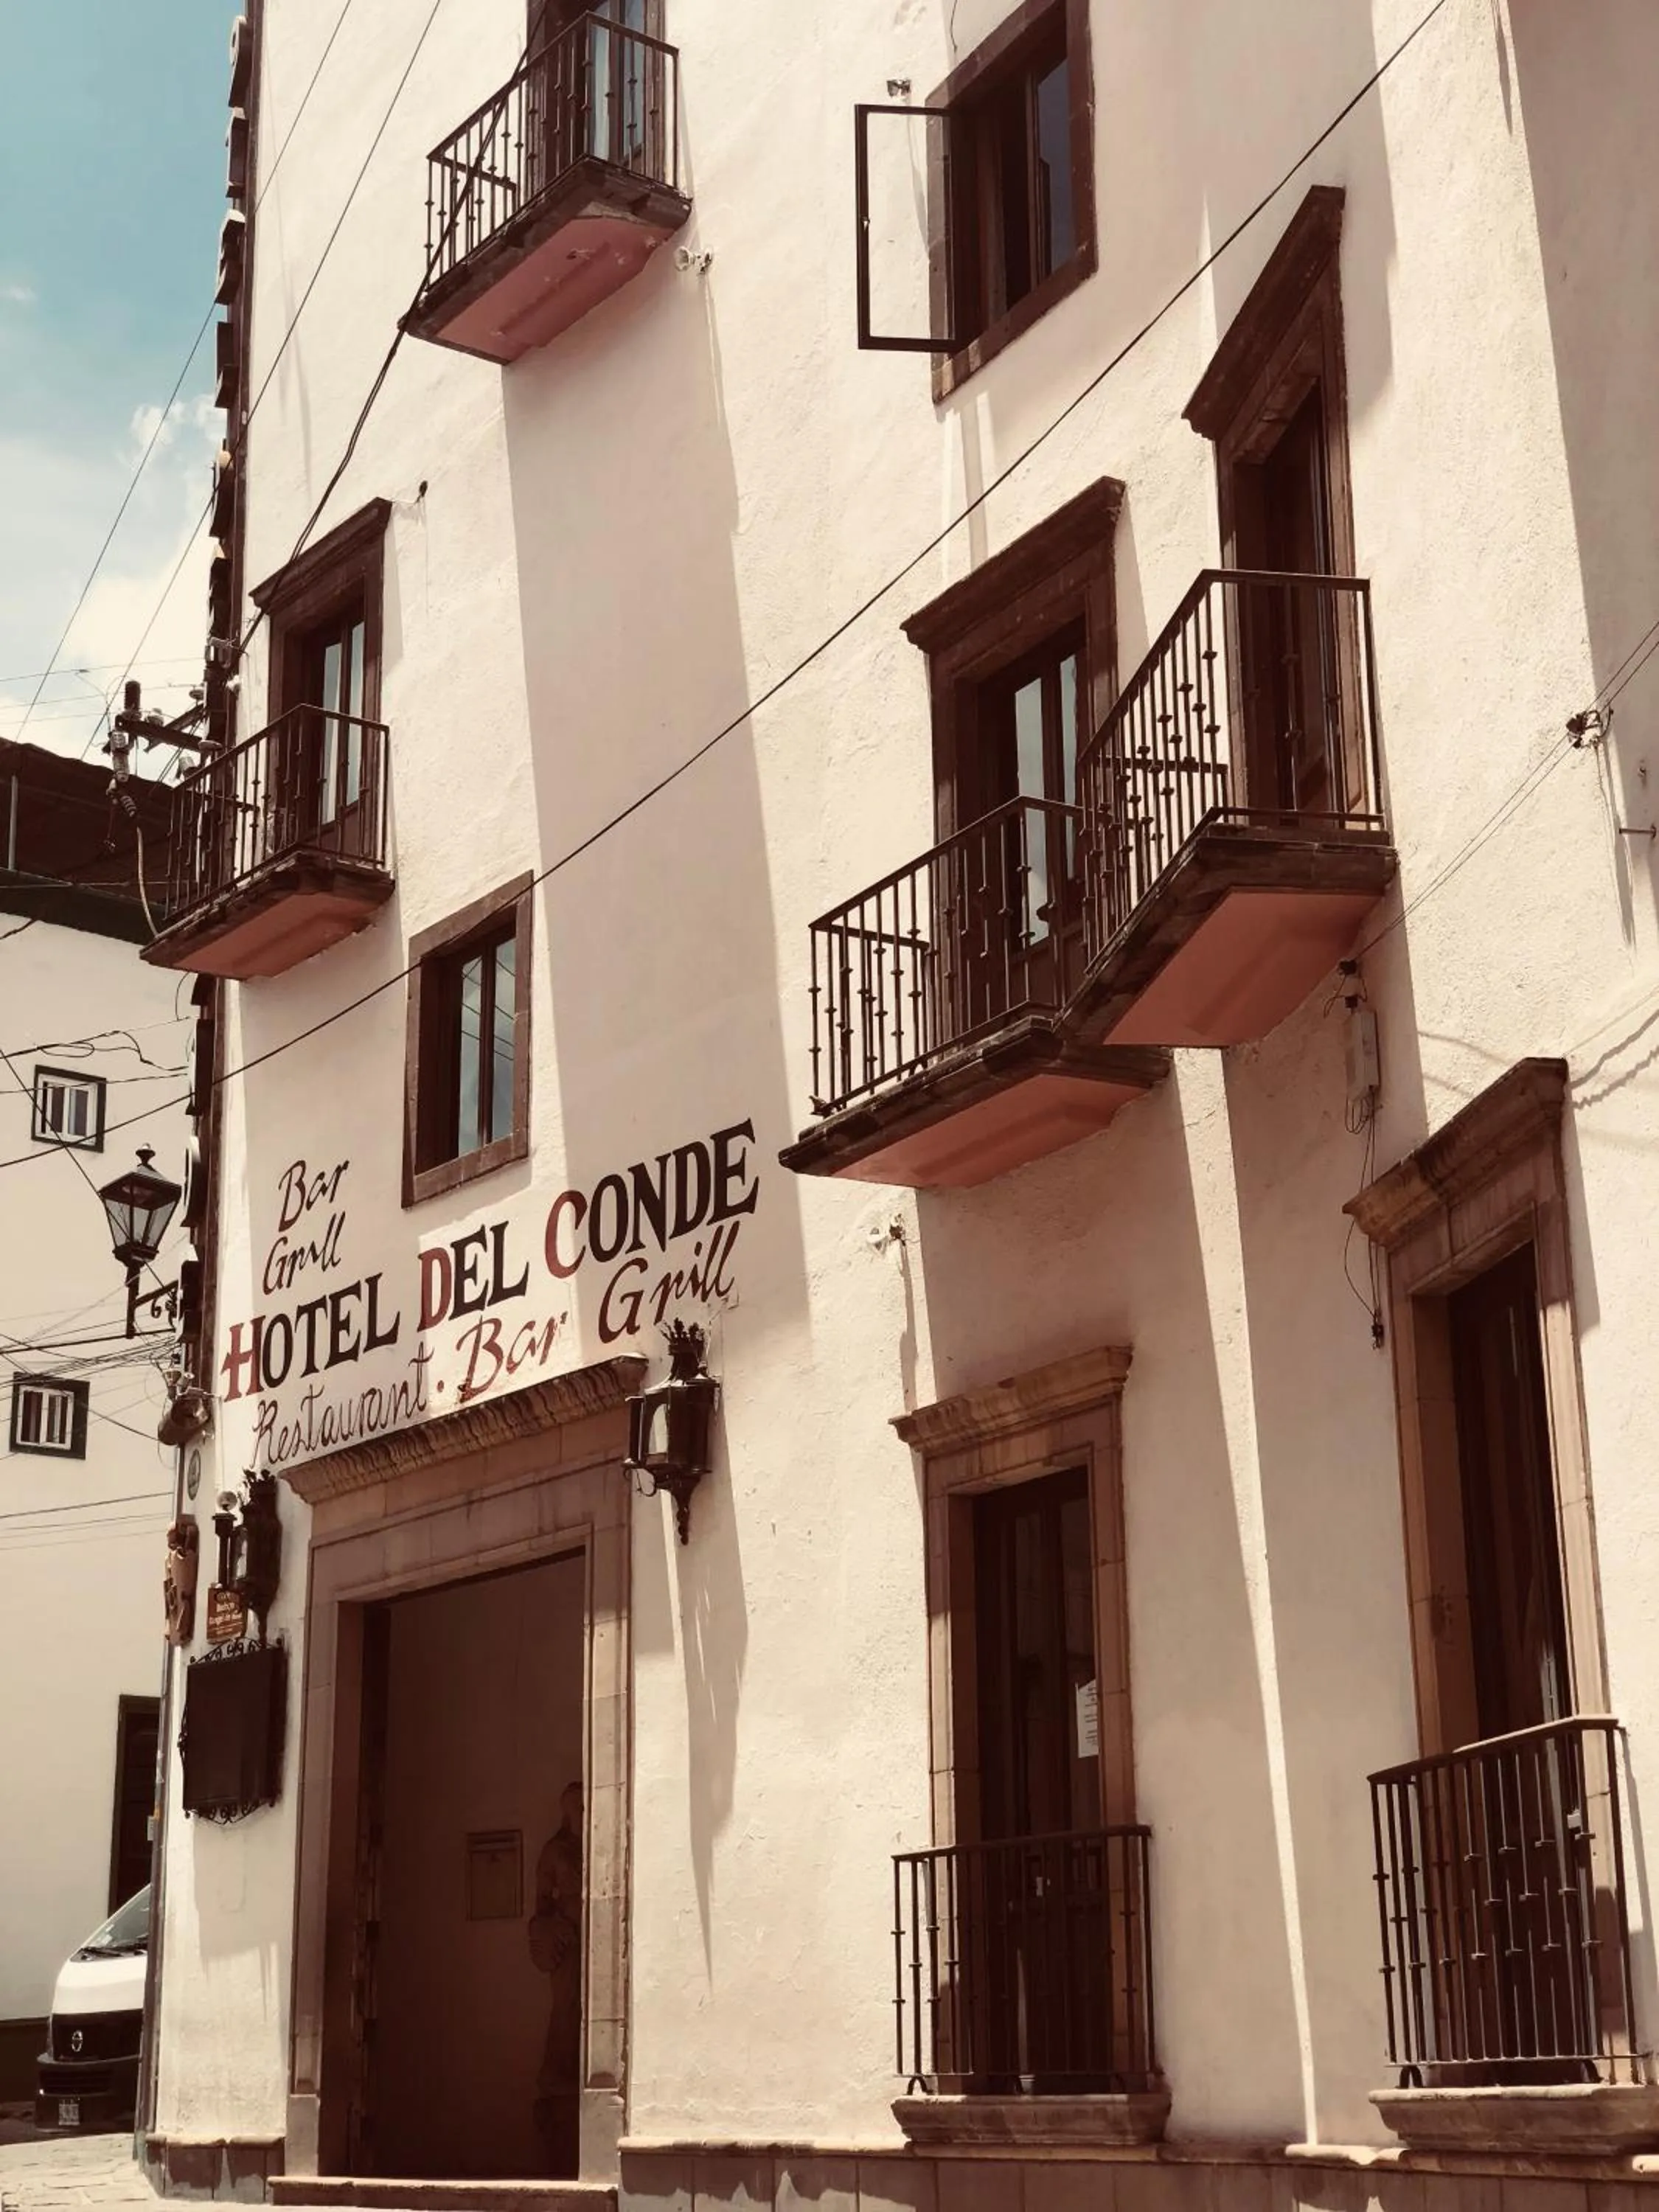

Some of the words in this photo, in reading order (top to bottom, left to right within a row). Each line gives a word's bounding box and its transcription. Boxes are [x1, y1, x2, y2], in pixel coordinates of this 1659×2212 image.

[221, 1272, 400, 1402] HOTEL
[417, 1220, 529, 1333] DEL
[544, 1119, 759, 1279] CONDE
[262, 1211, 346, 1295] Grill
[278, 1159, 349, 1233] Bar
[249, 1340, 435, 1470] Restaurant
[456, 1312, 568, 1404] Bar
[598, 1220, 740, 1344] Grill
